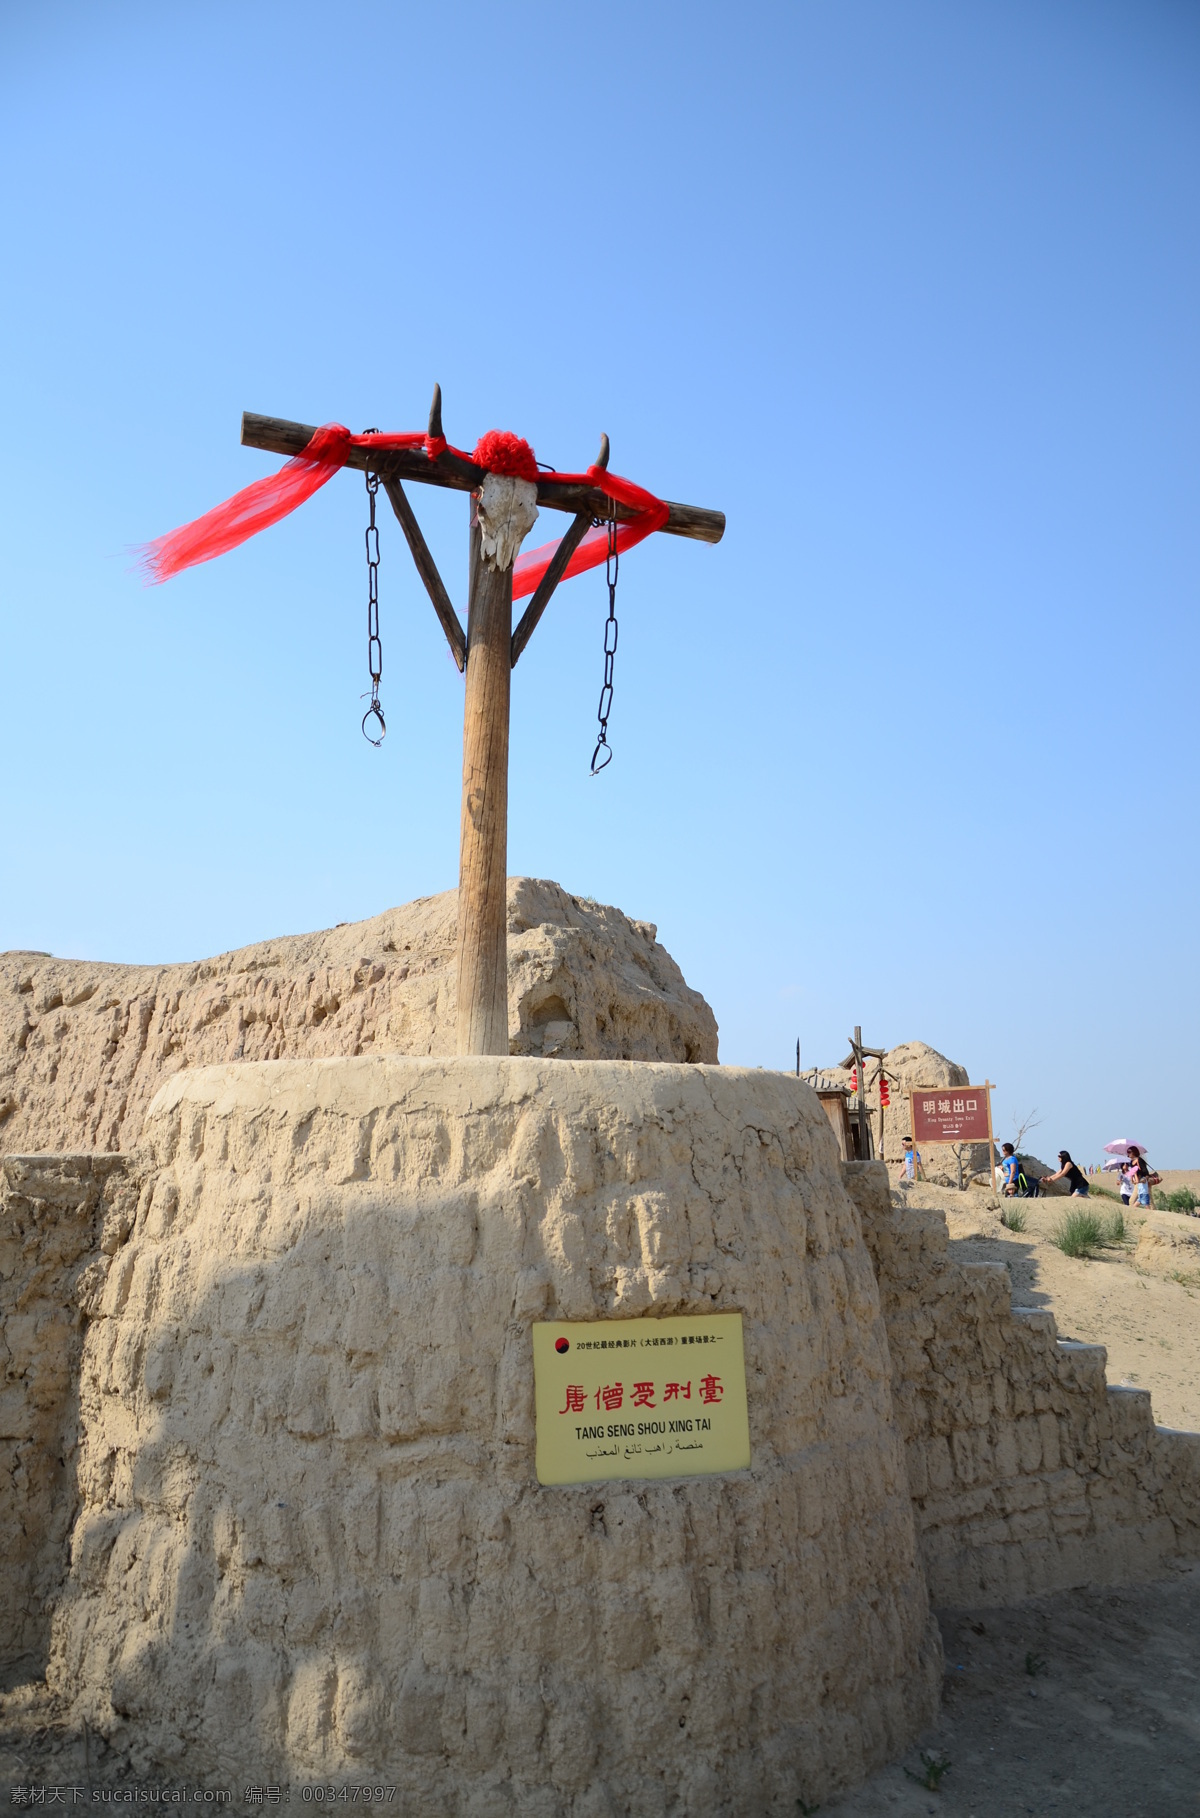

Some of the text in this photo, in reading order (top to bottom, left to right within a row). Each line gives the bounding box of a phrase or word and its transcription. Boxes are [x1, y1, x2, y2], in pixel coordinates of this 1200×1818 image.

[922, 1099, 977, 1114] 明城出口
[575, 1417, 712, 1441] TANG SENG SHOU XING TAI
[585, 1438, 704, 1461] منصة راهب تانغ المعذب
